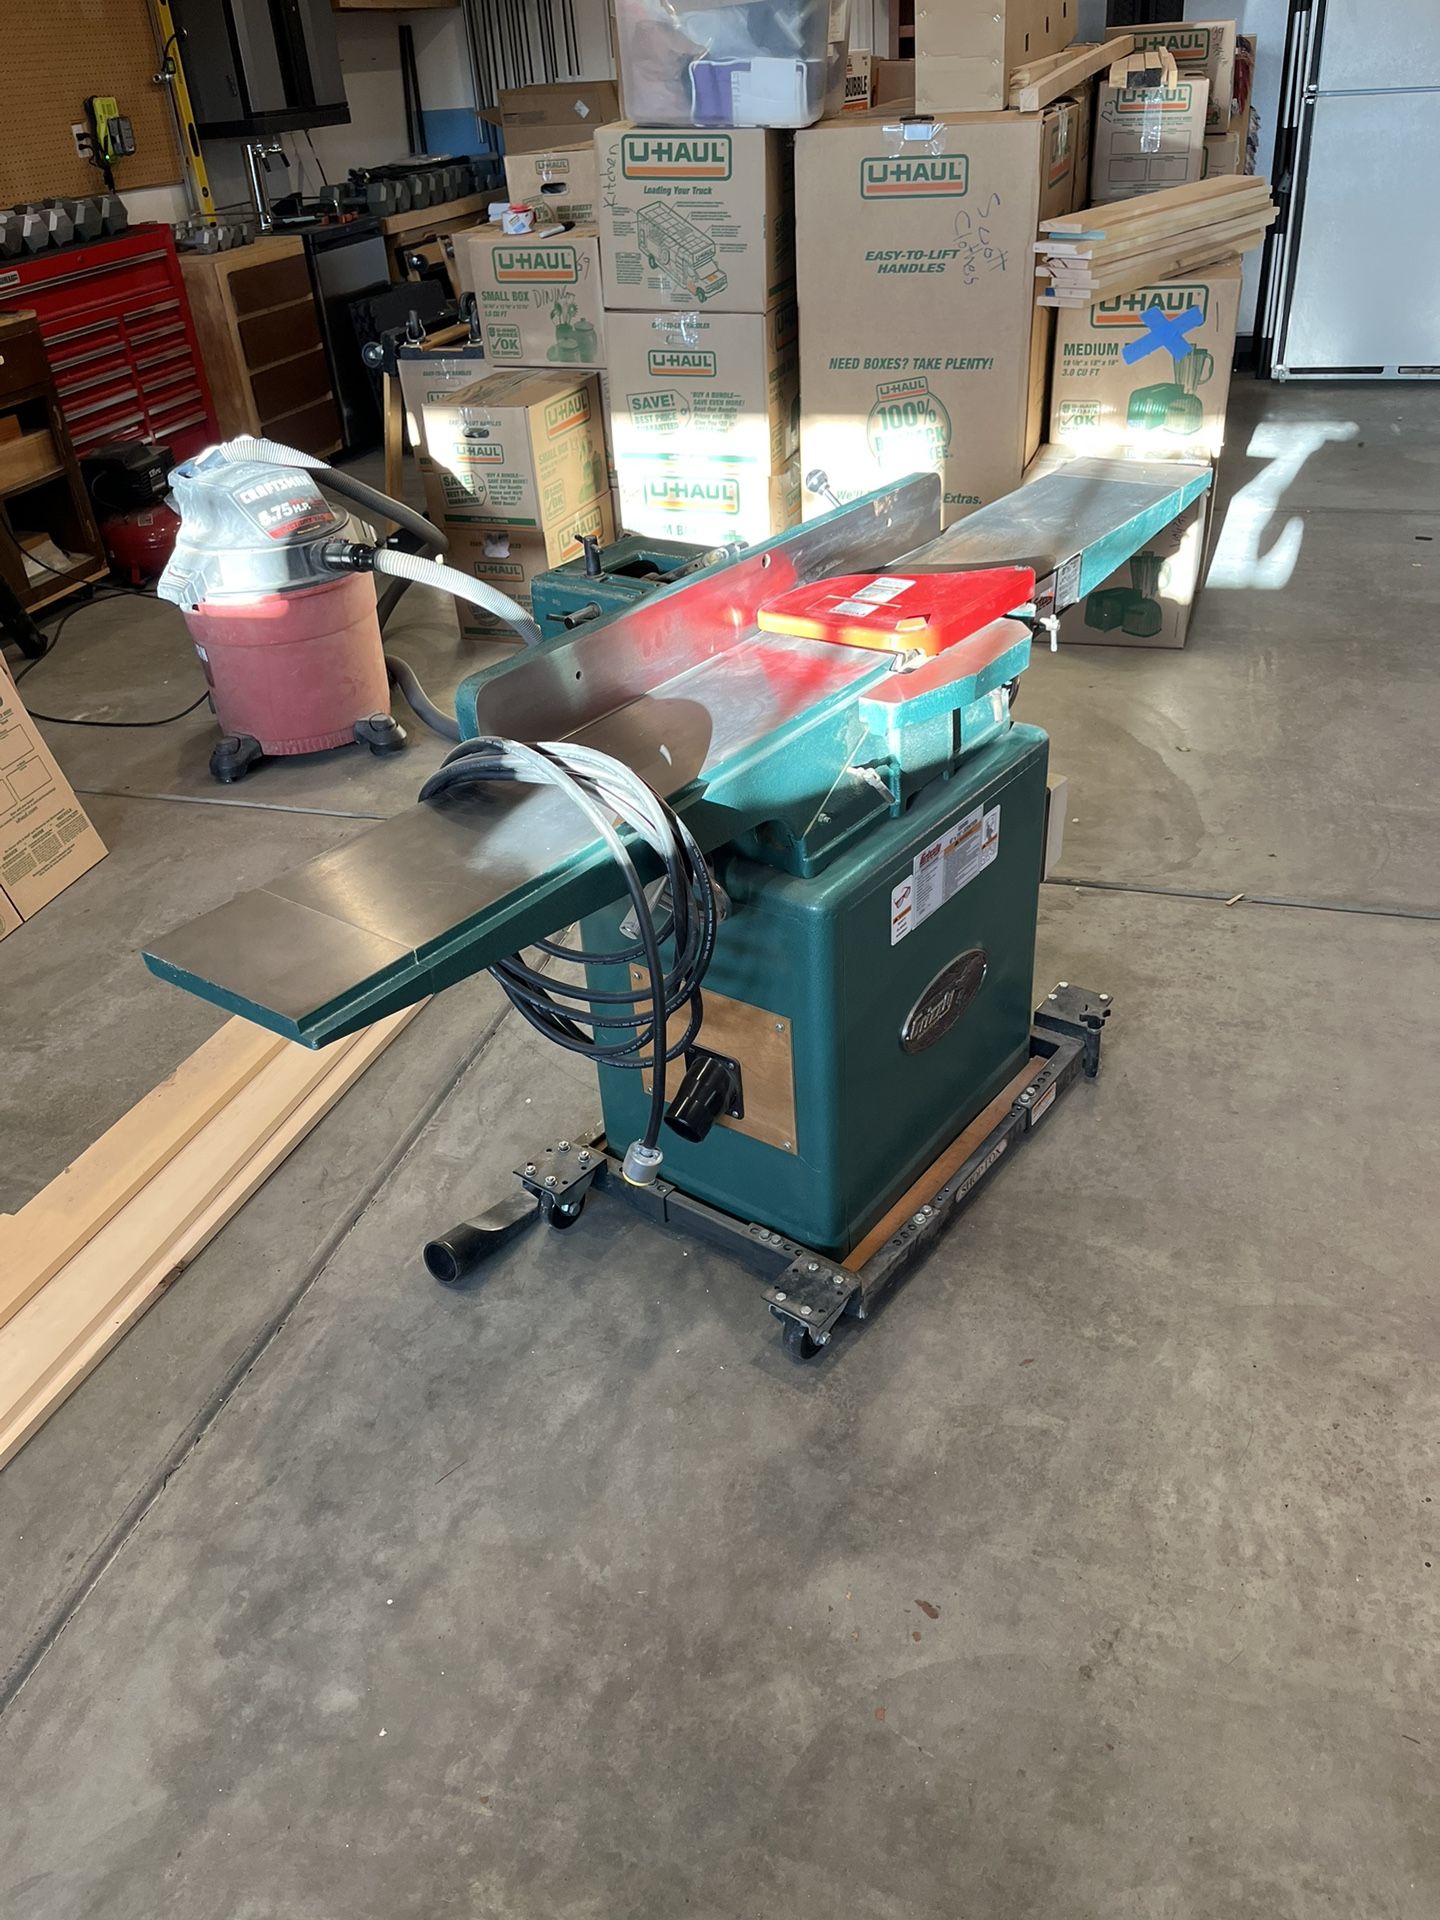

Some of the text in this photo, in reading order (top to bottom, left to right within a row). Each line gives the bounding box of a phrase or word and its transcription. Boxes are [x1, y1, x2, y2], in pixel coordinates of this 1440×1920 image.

[629, 142, 725, 162] U-HAUL
[601, 144, 619, 209] Kitchen
[868, 162, 962, 183] U-HAUL
[643, 186, 713, 197] Loading Your Truck
[499, 252, 572, 270] U-HAUL
[865, 249, 960, 262] EASY-TO-LIFT
[877, 263, 946, 274] HANDLES
[481, 291, 530, 302] SMALL BOX
[500, 339, 519, 350] OK
[1063, 343, 1119, 356] MEDIUM
[652, 354, 712, 367] U-HAUL
[829, 358, 994, 370] NEED BOXES? TAKE PLENTY!
[1062, 368, 1100, 377] 3.0 CU FT
[879, 380, 925, 395] U-HAUL
[547, 393, 589, 423] U-HAUL
[631, 394, 676, 410] SAVE!
[634, 412, 678, 424] BEST PRICE
[876, 399, 937, 432] 100%
[1073, 415, 1096, 426] OK
[457, 446, 501, 457] U-HAUL
[240, 475, 312, 505] CRAFTSMAN
[651, 482, 736, 500] U-HAUL
[943, 493, 982, 505] Extras.
[560, 512, 601, 548] U-HAUL
[477, 564, 521, 575] U-HAUL
